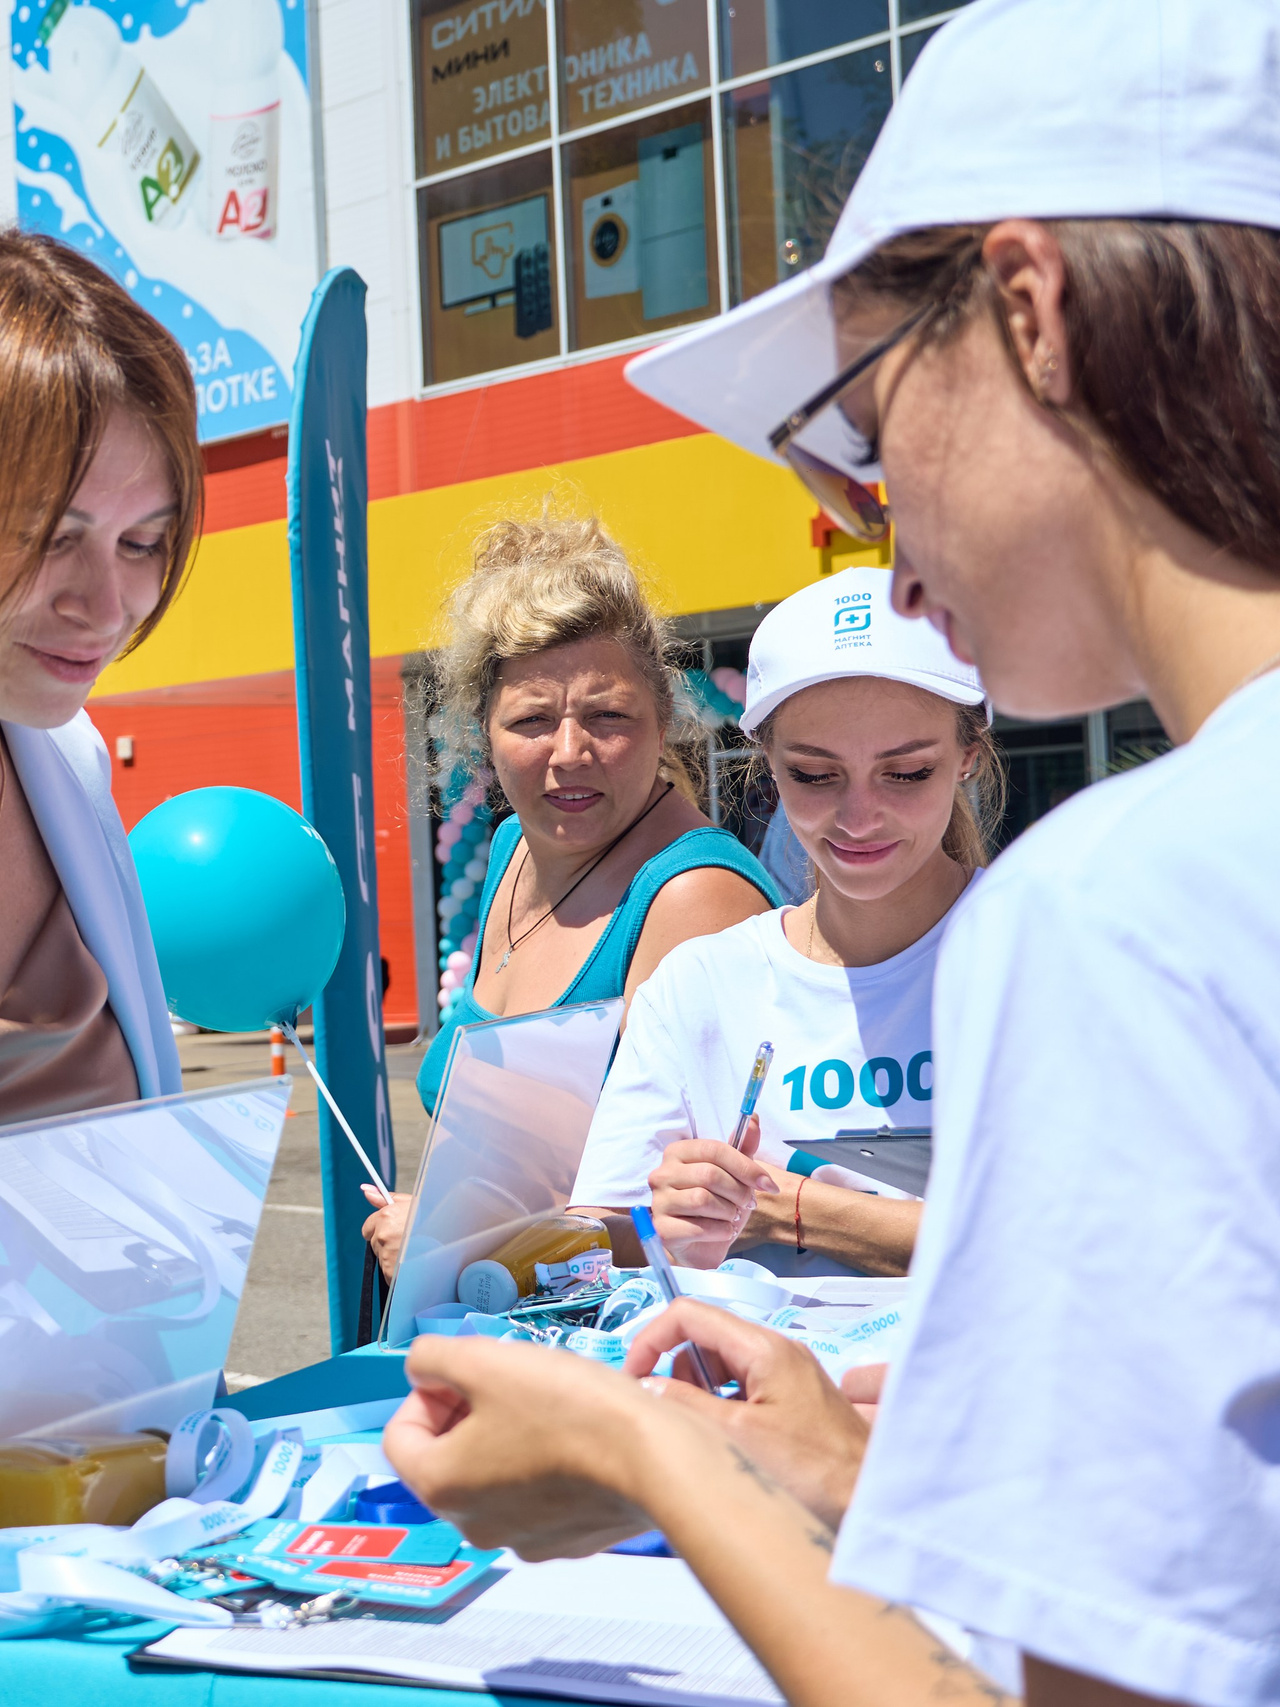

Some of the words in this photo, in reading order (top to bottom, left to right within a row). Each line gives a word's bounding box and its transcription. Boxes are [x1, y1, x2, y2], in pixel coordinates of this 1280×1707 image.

[432, 38, 510, 85] МИНИ
[472, 32, 652, 114] ЭЛЕКТОНИКА
[436, 133, 451, 160] И
[577, 51, 699, 114] ТЕХНИКА
[834, 592, 872, 606] 1000
[834, 634, 871, 644] МАГНИТ
[834, 641, 872, 651] АПТЕКА
[782, 1050, 933, 1111] 1000
[872, 1311, 902, 1332] 1000
[271, 1444, 294, 1476] 1000
